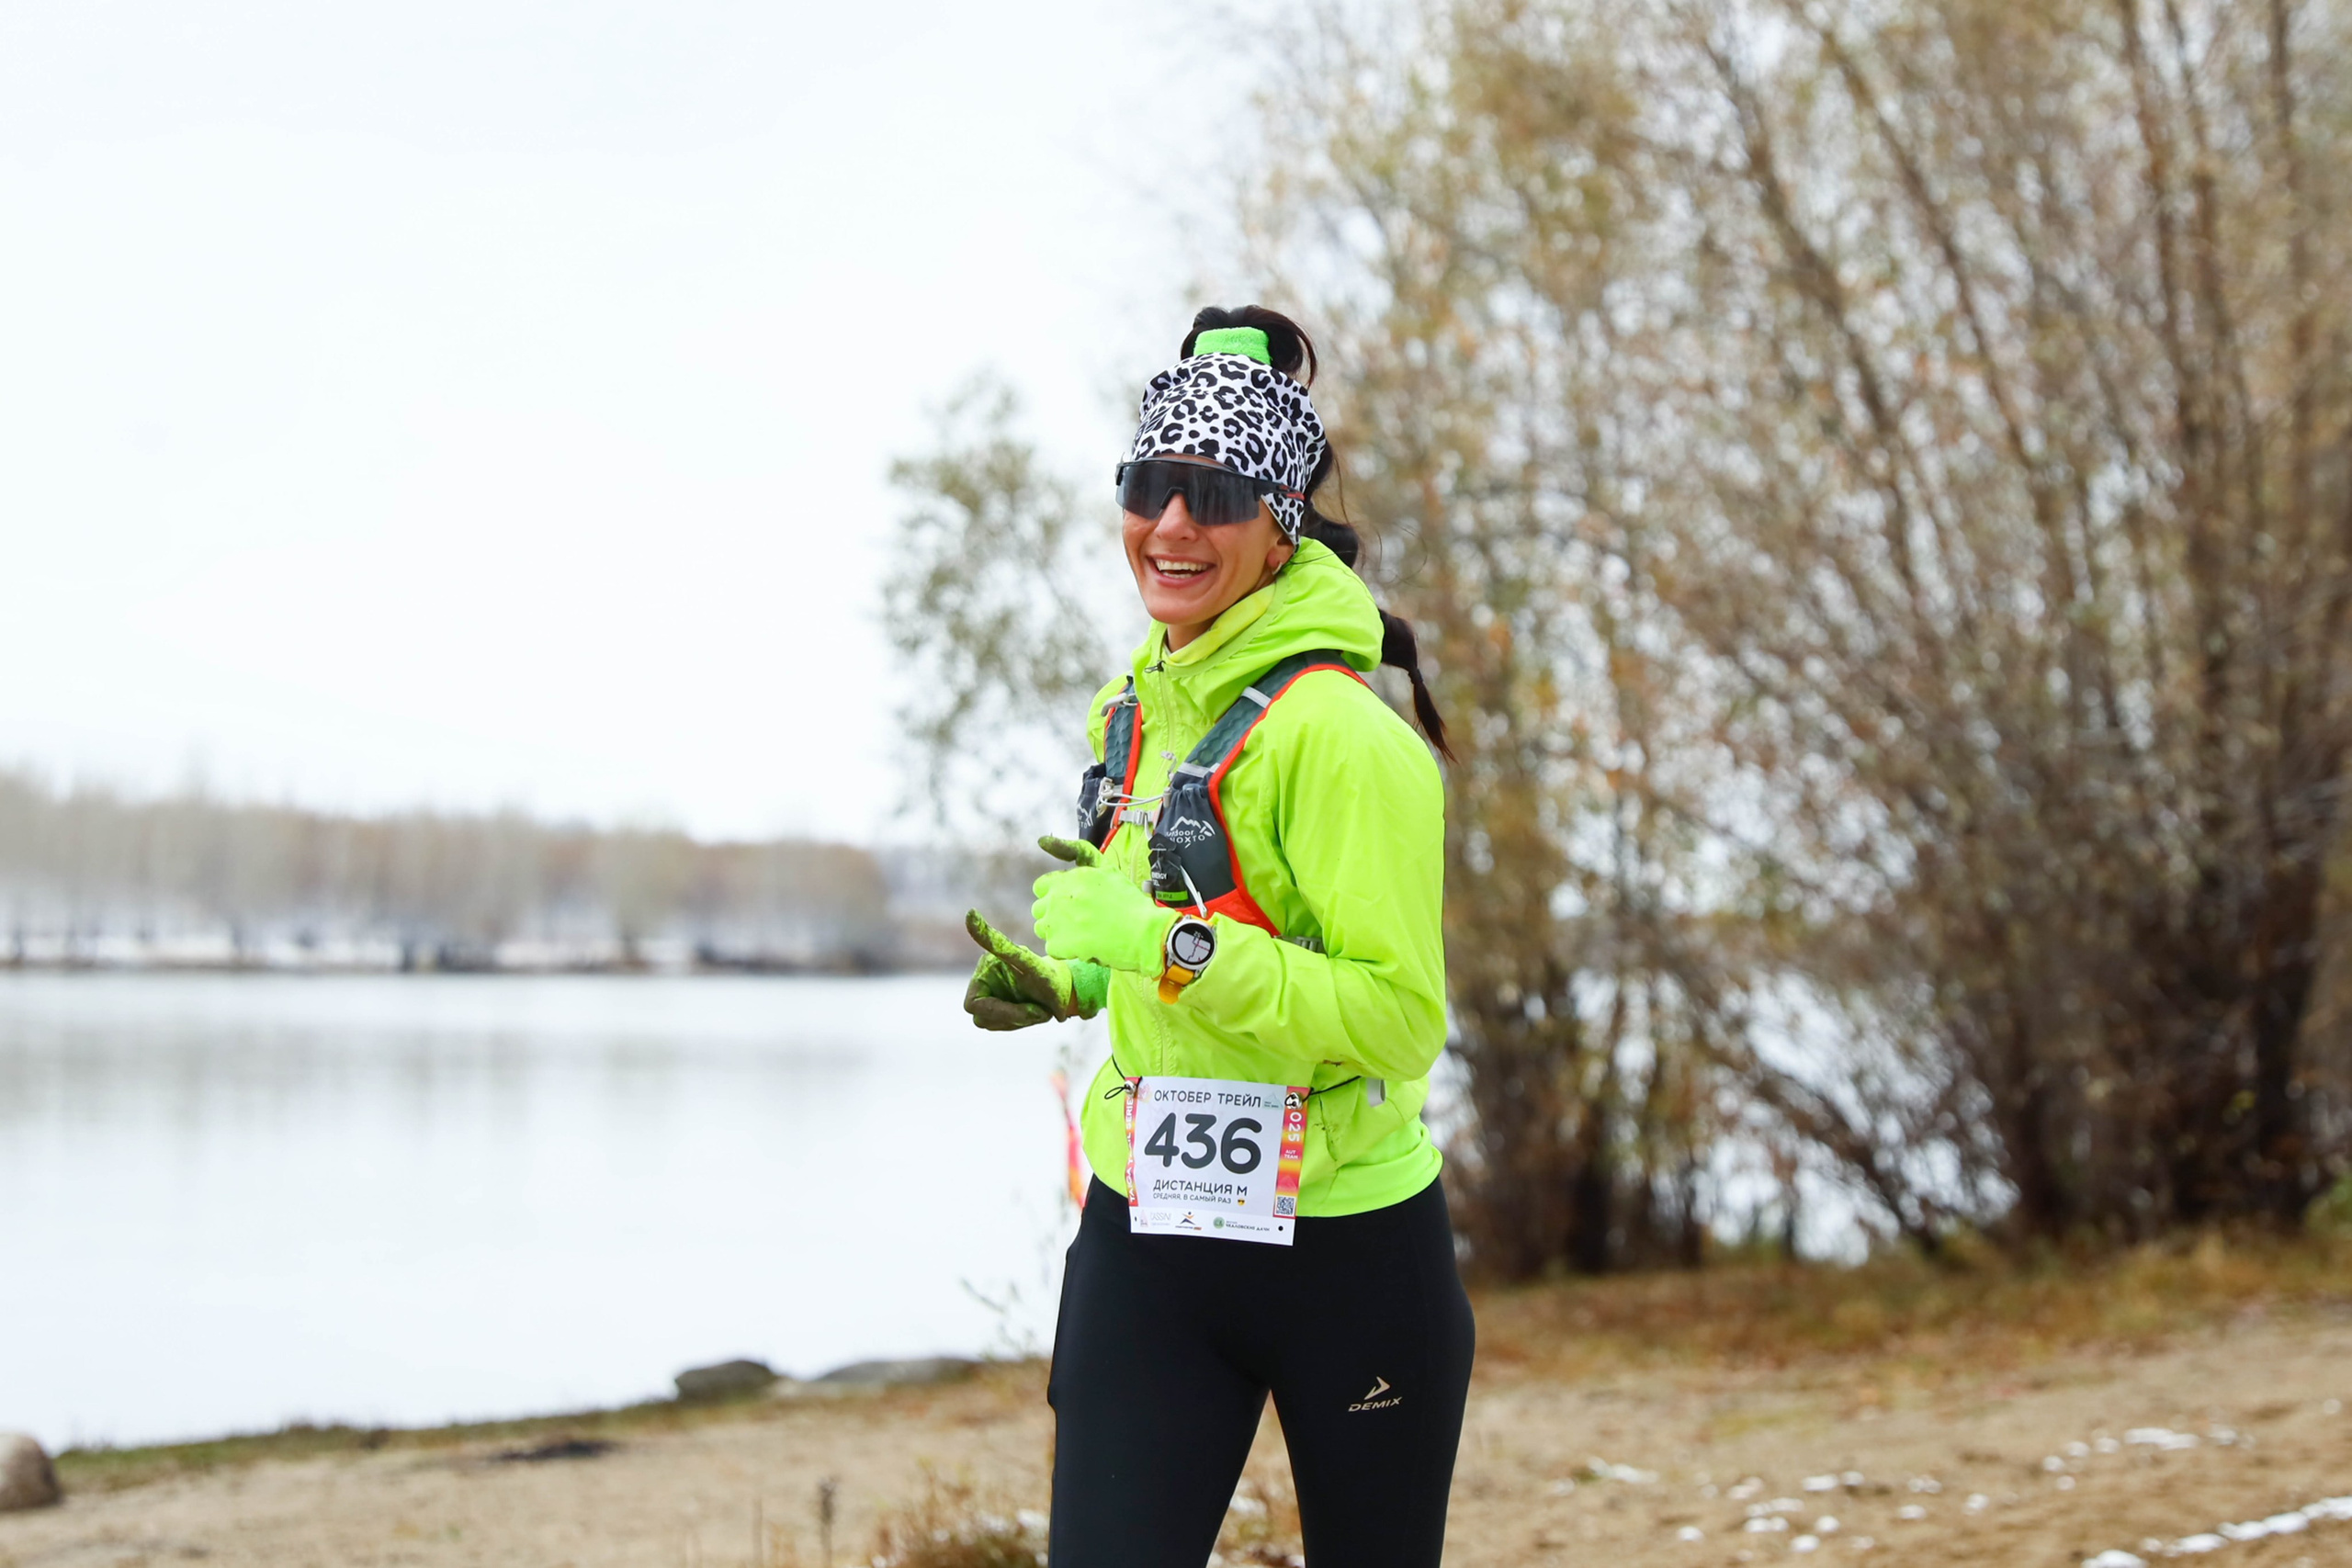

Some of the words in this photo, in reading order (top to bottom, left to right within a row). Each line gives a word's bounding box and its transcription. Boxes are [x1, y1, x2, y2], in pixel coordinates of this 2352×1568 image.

[1165, 829, 1194, 837] utdoor
[1154, 1089, 1212, 1103] ОКТОБЕР
[1218, 1092, 1261, 1108] ТРЕЙЛ
[1125, 1095, 1134, 1130] SERIE
[1288, 1109, 1302, 1142] 025
[1144, 1112, 1262, 1175] 436
[1125, 1167, 1136, 1202] TAIGA
[1153, 1179, 1232, 1195] ДИСТАНЦИЯ
[1190, 1194, 1216, 1202] САМЫЙ
[1348, 1396, 1403, 1412] DEMIX
